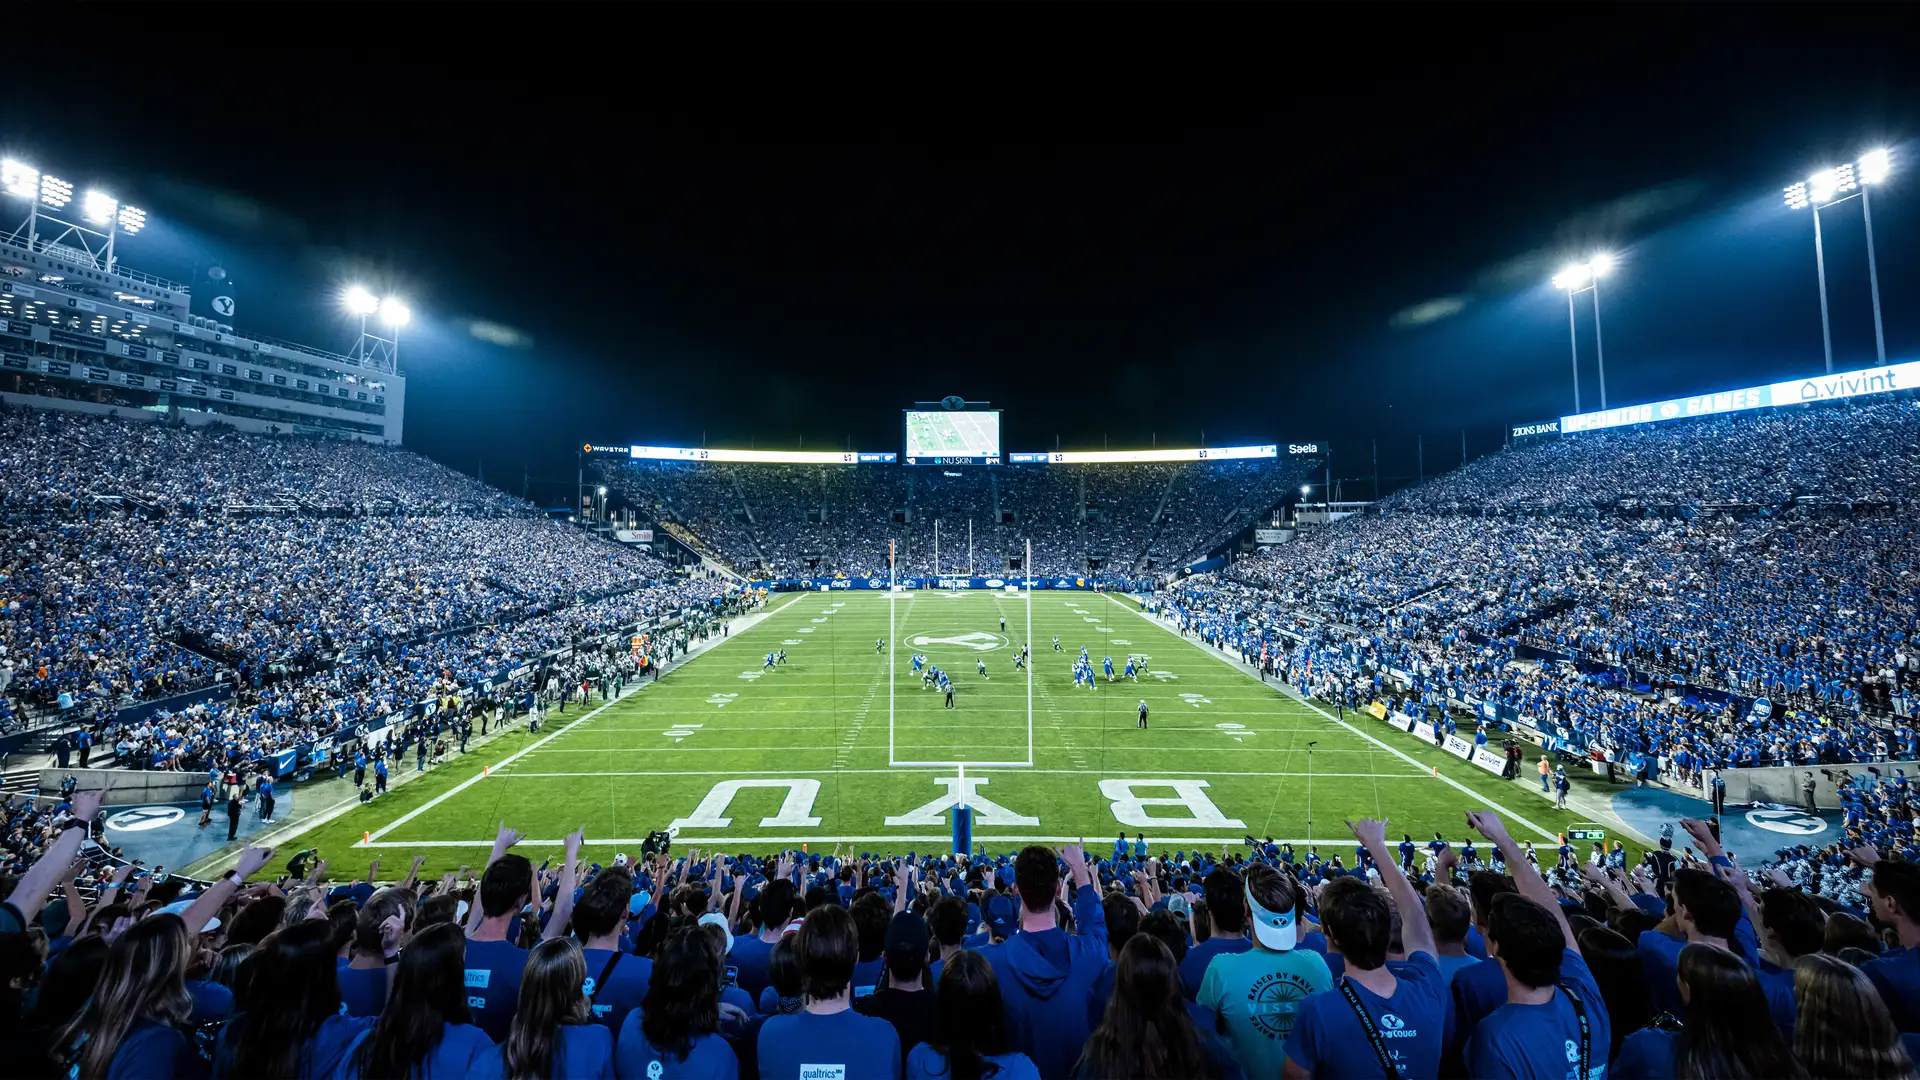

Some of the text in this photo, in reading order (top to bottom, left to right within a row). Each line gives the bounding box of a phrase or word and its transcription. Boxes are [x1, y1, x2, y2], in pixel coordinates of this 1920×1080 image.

[118, 280, 171, 300] STADIUM
[218, 297, 233, 314] Y
[1567, 388, 1761, 431] UPCOMING GAMES
[1512, 421, 1559, 437] ZIONS BANK
[906, 457, 916, 465] 40
[1247, 971, 1316, 1001] RAISED BY WAVE
[1247, 1002, 1294, 1015] VISS
[1249, 1015, 1275, 1040] WAVES
[1343, 986, 1357, 1003] BYU
[1374, 1039, 1391, 1068] NATION
